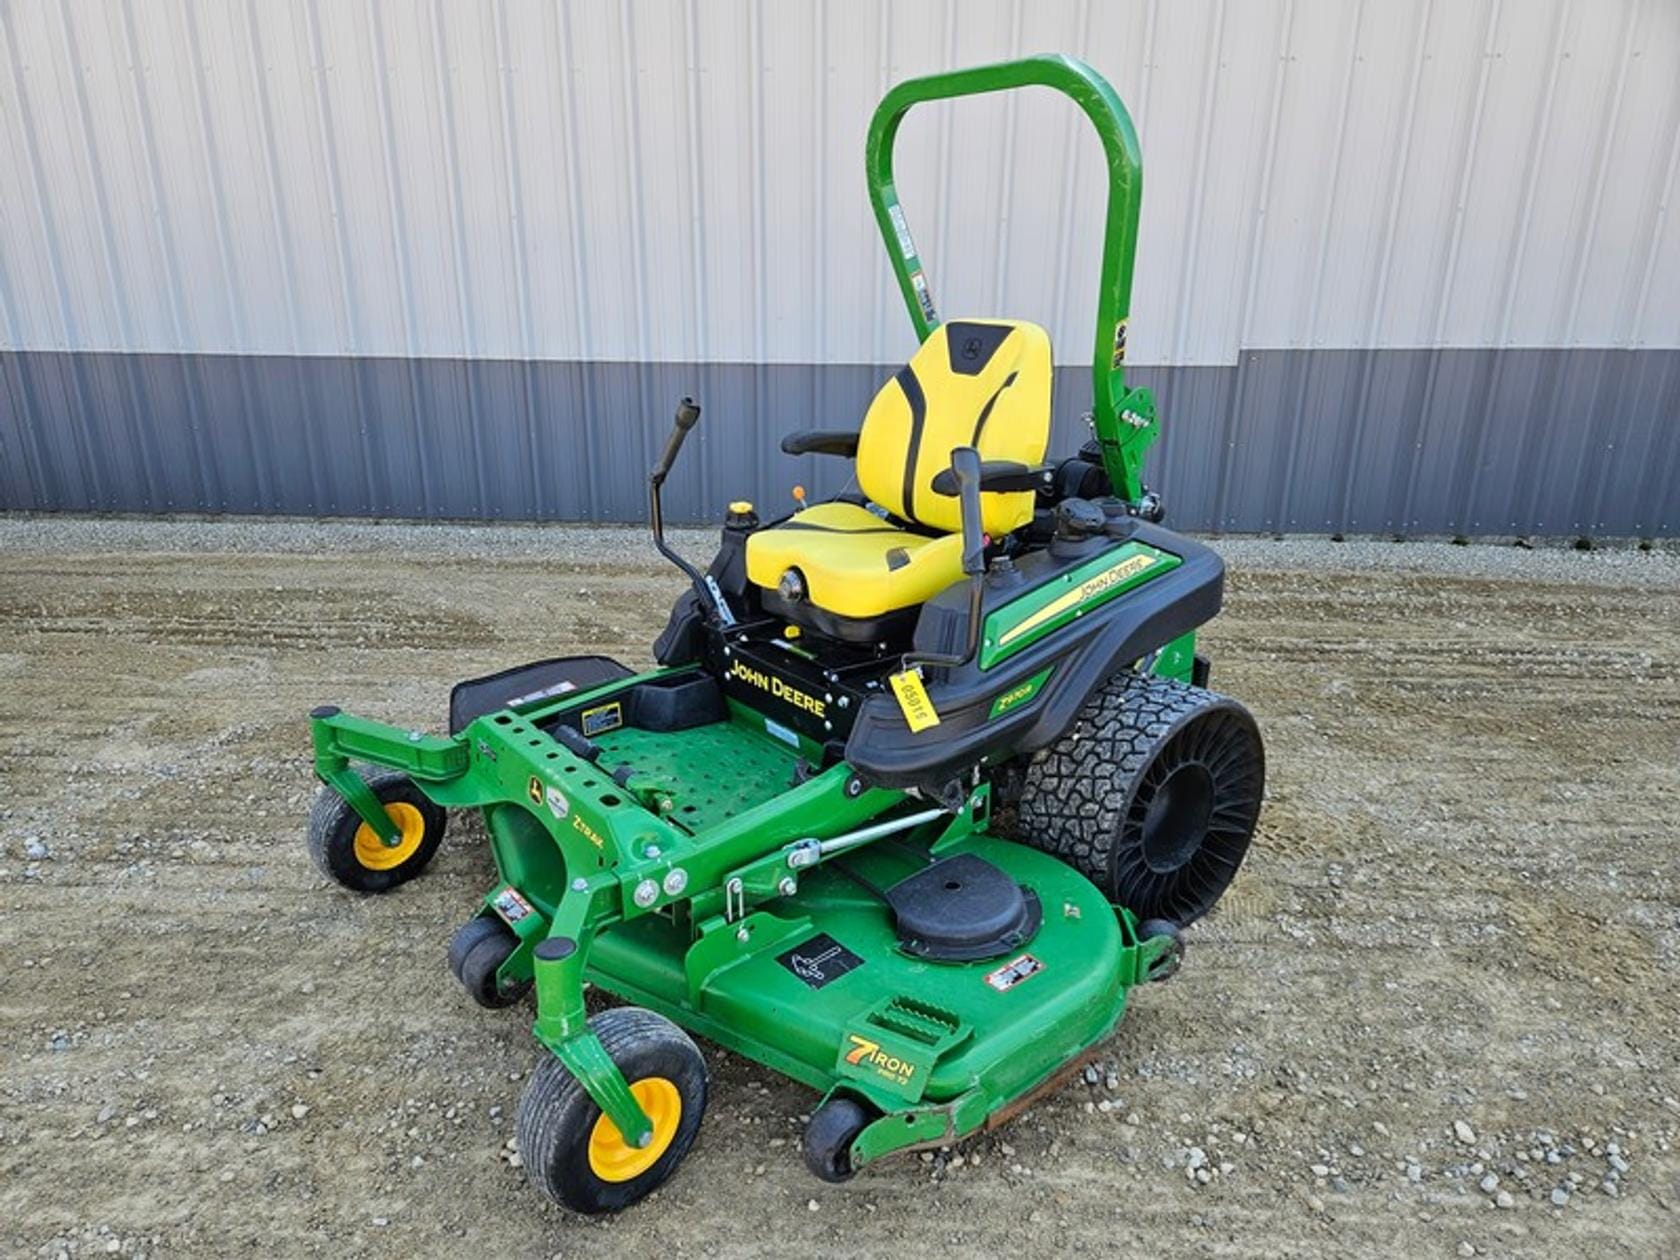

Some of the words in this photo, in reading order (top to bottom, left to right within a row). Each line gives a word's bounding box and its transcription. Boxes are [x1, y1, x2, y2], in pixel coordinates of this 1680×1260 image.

[1080, 577, 1108, 600] JOHN
[730, 659, 769, 691] JOHN
[771, 676, 826, 718] DEERE
